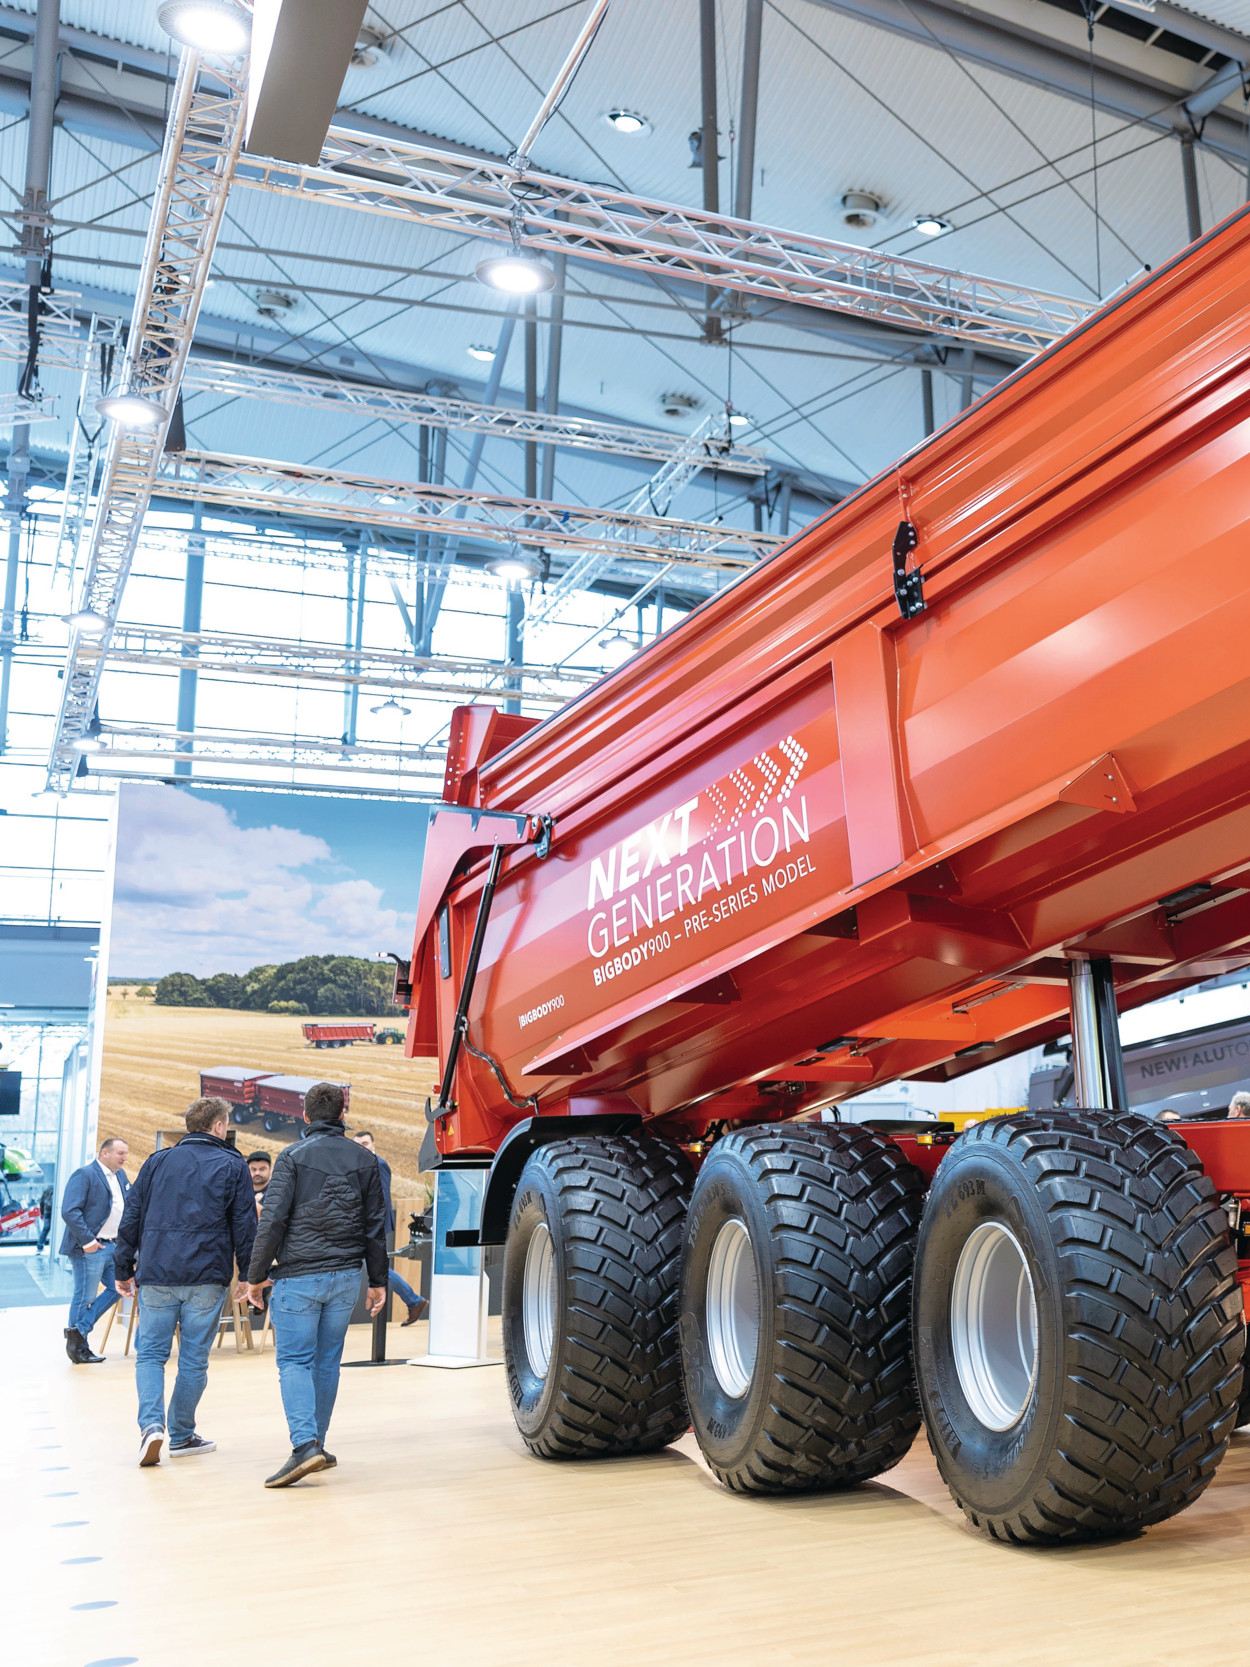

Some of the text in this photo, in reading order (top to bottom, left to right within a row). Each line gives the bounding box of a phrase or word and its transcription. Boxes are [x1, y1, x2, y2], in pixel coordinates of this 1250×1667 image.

[586, 796, 699, 910] NEXT
[587, 795, 811, 959] GENERATION
[593, 931, 671, 986] BIGBODY900
[684, 888, 759, 937] PRE-SERIES
[762, 856, 817, 894] MODEL
[519, 994, 565, 1029] BIGBODY900
[1140, 1056, 1190, 1079] NEW!
